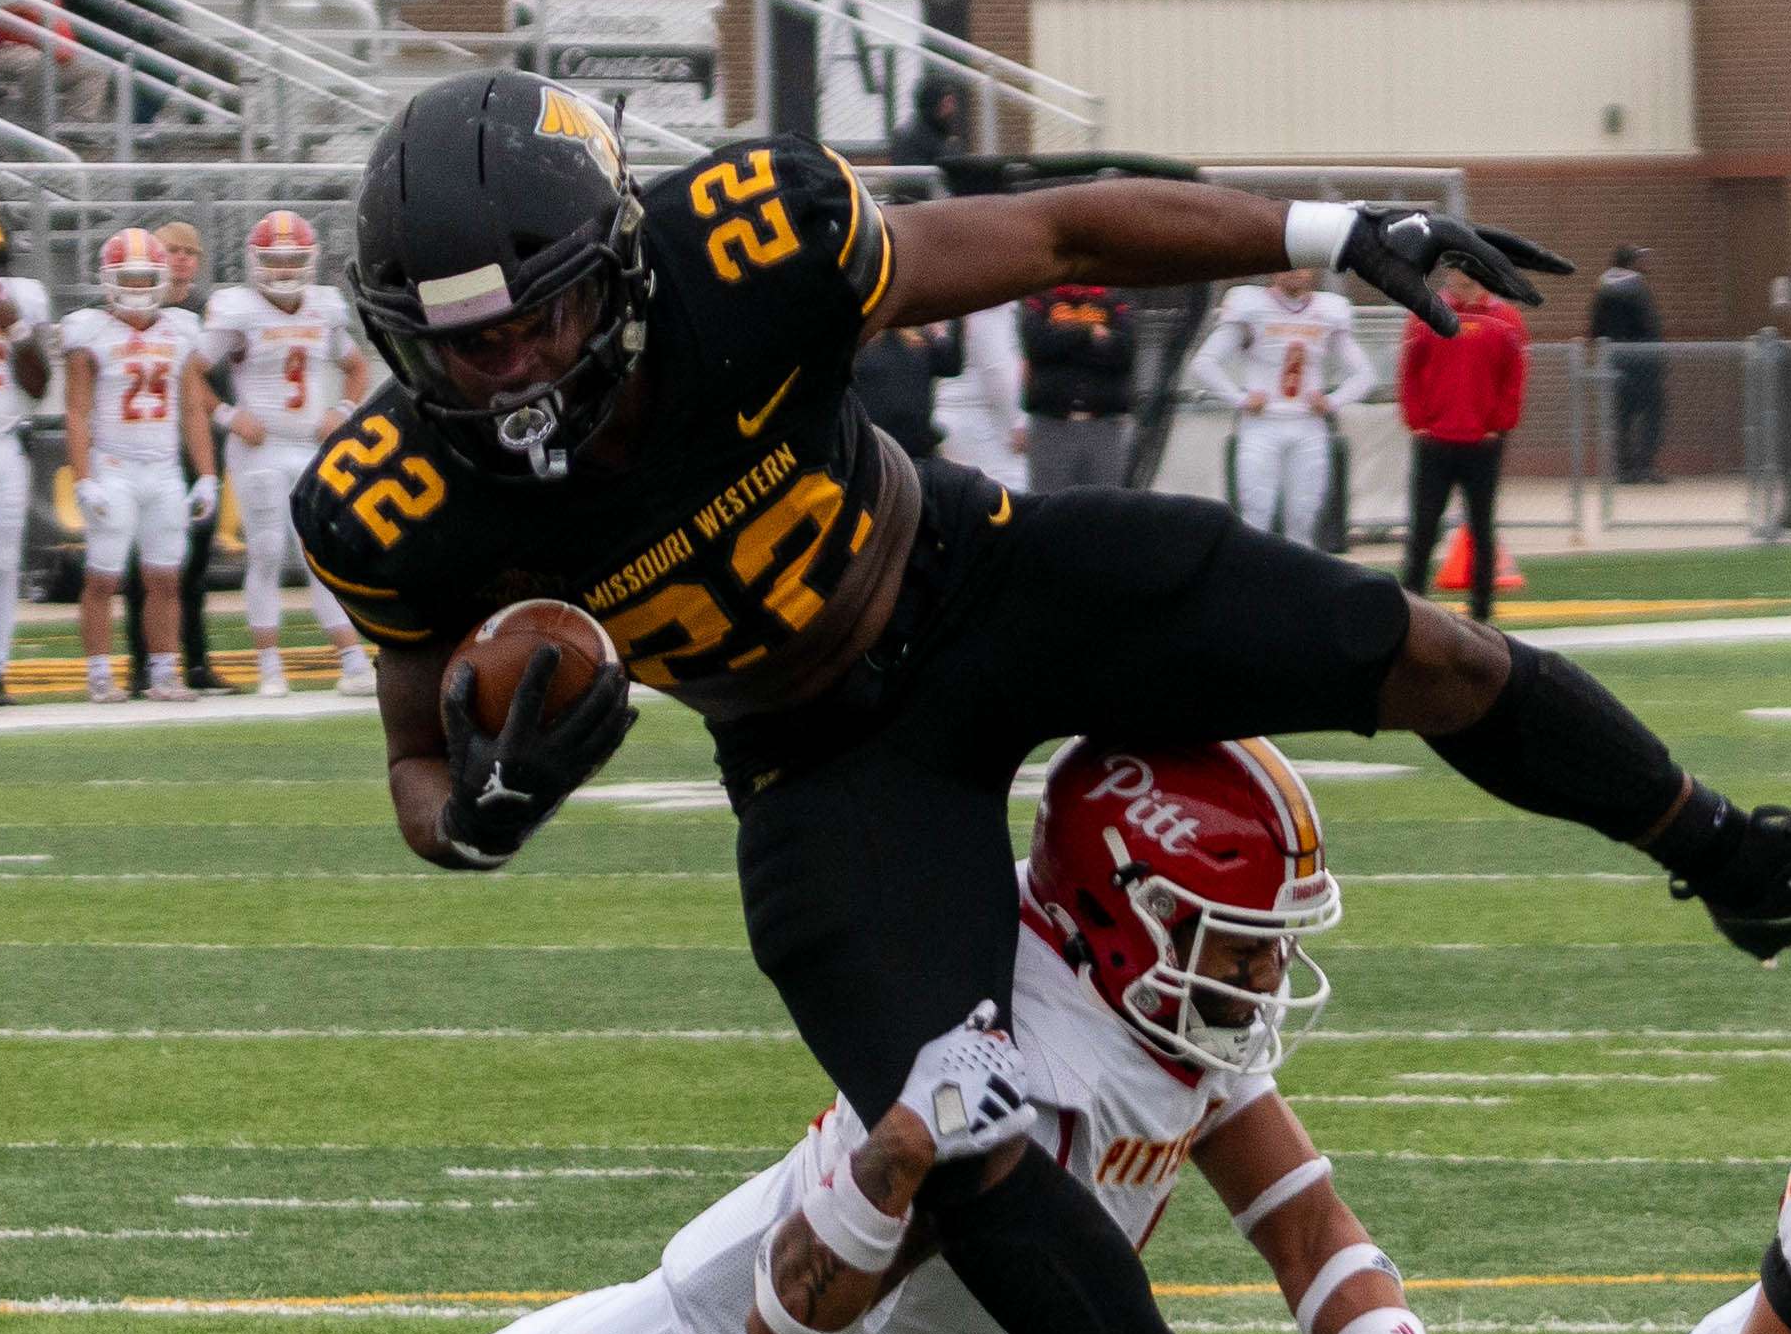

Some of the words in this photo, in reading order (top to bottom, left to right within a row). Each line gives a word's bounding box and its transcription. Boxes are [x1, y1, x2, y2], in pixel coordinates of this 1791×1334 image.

[689, 149, 801, 283] 22
[317, 413, 448, 550] 22
[582, 527, 697, 613] MISSOURI
[692, 440, 799, 541] WESTERN
[1082, 753, 1202, 856] Pitt
